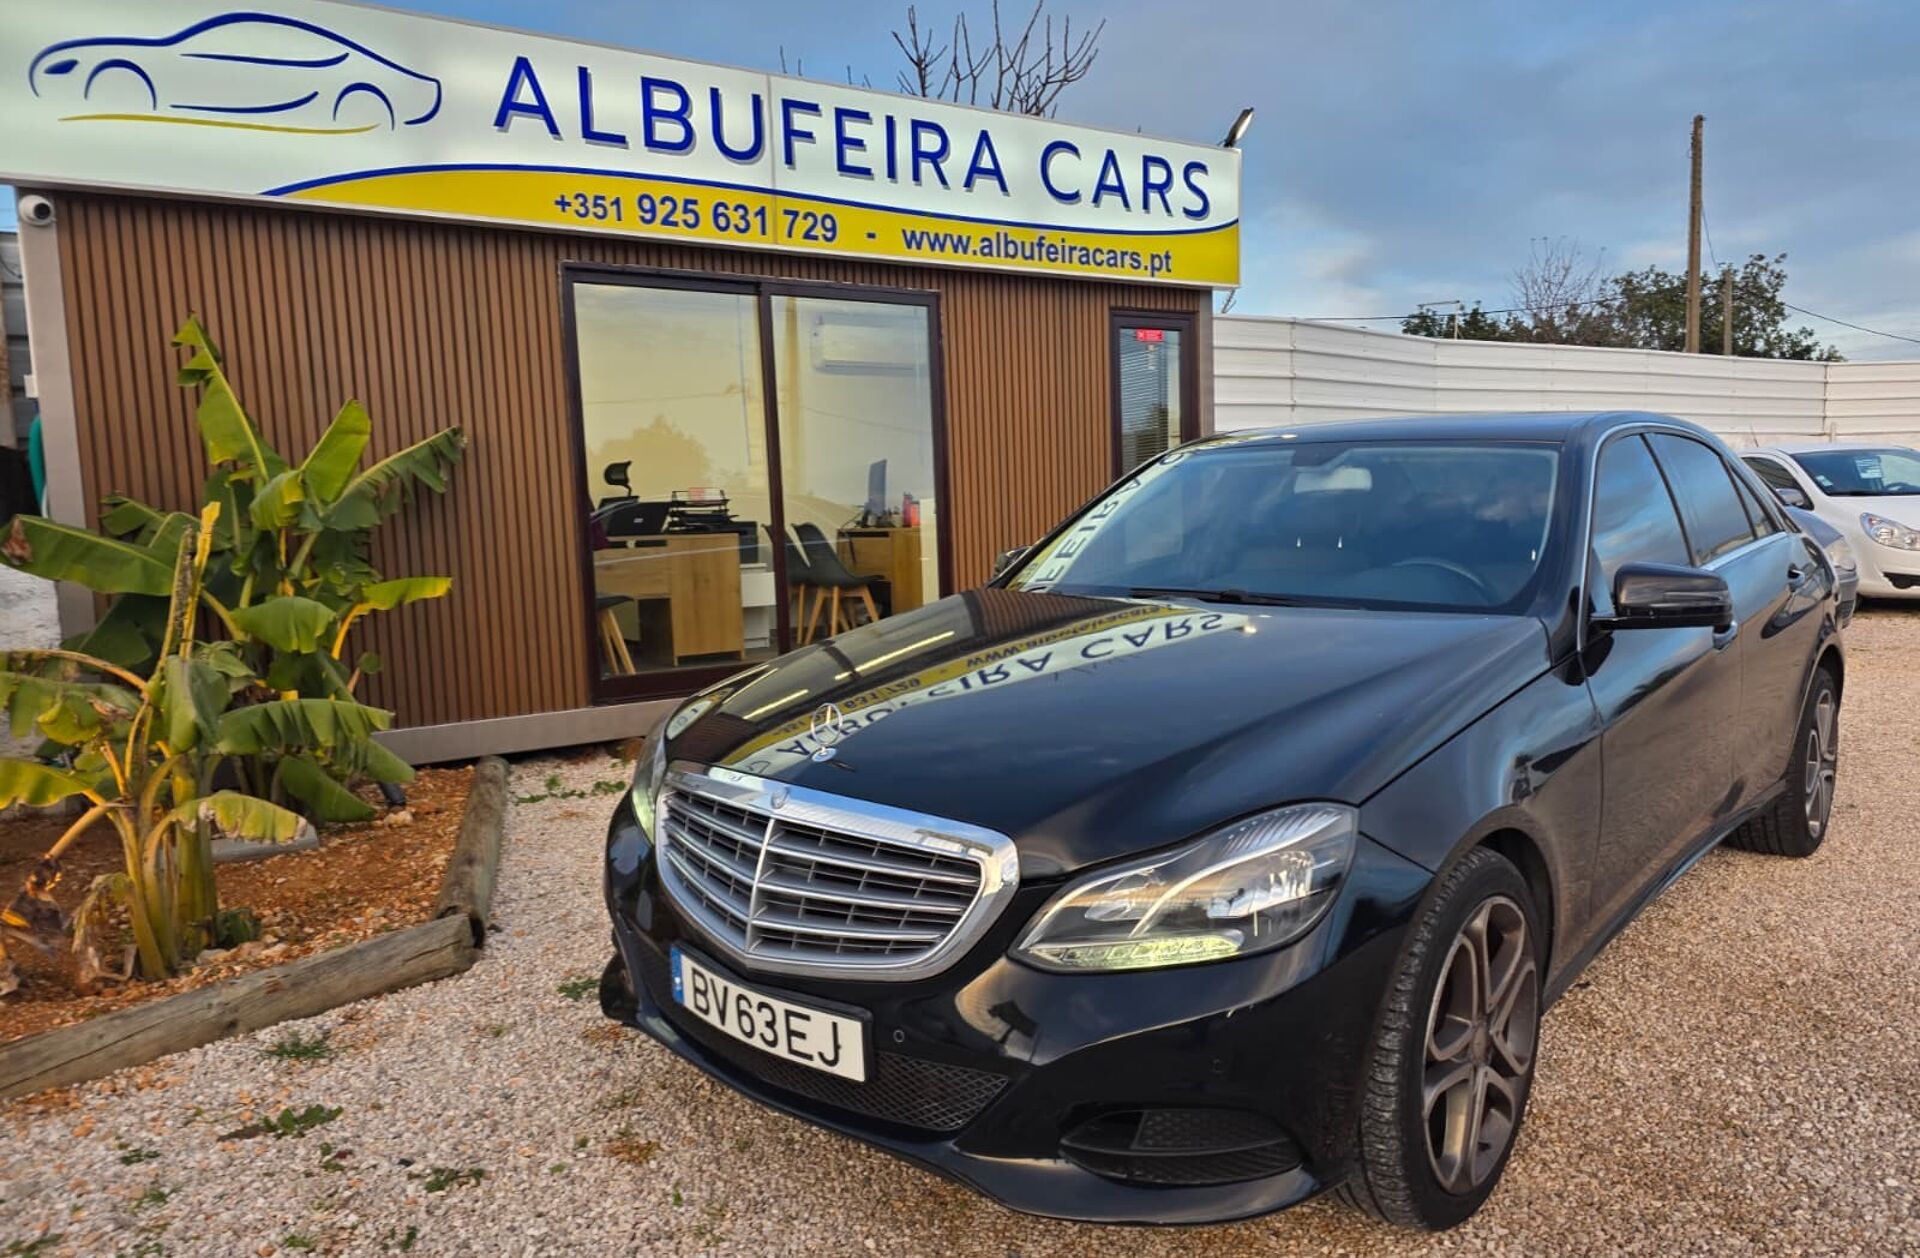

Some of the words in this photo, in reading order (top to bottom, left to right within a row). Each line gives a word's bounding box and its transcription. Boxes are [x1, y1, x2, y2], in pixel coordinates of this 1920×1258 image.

[493, 55, 1010, 197] ALBUFEIRA
[1039, 140, 1210, 222] CARS
[554, 192, 623, 222] +351
[636, 193, 701, 229] 925
[711, 200, 767, 236] 631
[782, 209, 838, 243] 729
[902, 228, 1173, 278] www.albufeiracars.pt
[691, 966, 844, 1068] BV63EJ
